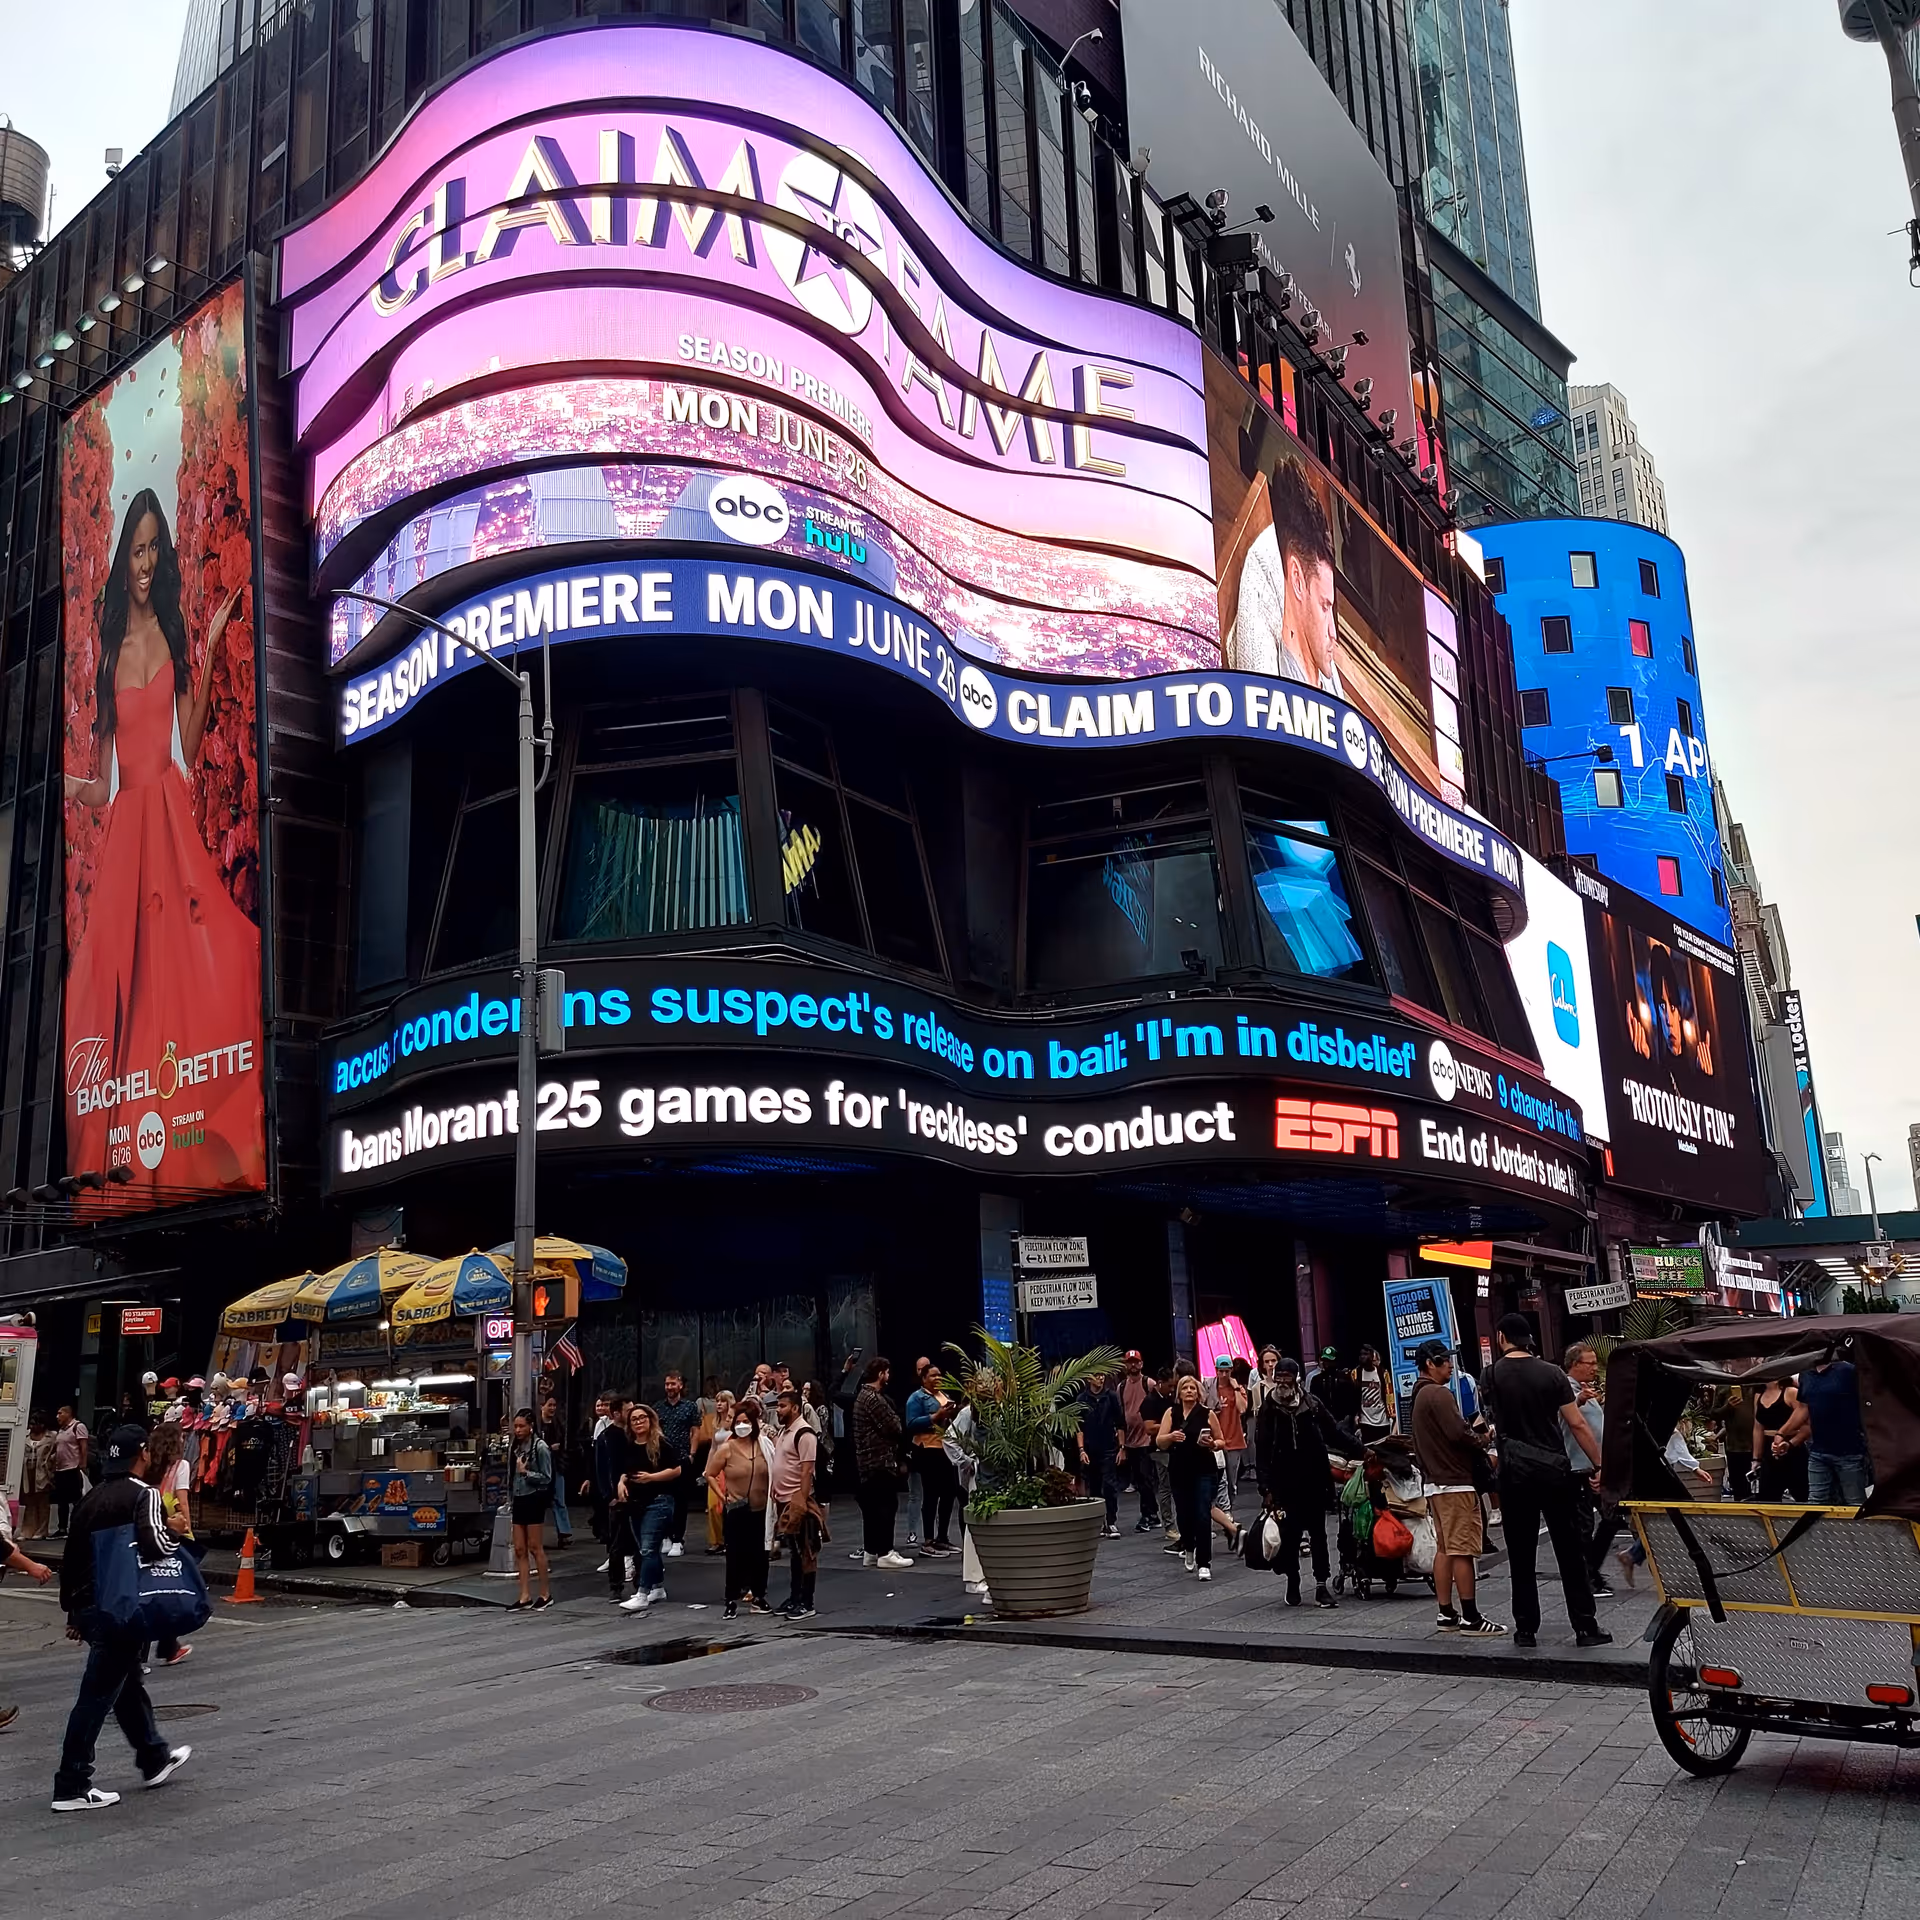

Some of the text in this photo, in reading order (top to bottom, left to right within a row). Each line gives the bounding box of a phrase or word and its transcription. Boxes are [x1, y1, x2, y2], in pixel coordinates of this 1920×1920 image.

[1198, 46, 1320, 232] RICHARD MILLE
[370, 124, 758, 318] CLAIM
[1298, 288, 1333, 343] FERARI
[882, 240, 1136, 479] FAME
[677, 334, 874, 446] SEASON PREMIERE
[662, 387, 870, 492] MON JUNE 26
[715, 495, 784, 524] abc
[806, 505, 867, 541] STREAM ON
[805, 518, 868, 564] hulu
[342, 629, 440, 738] SEASON
[443, 570, 674, 667] PREMIERE
[706, 572, 836, 641] MON
[848, 599, 932, 680] JUNE
[936, 644, 958, 704] 26
[961, 681, 994, 711] abc
[1006, 689, 1156, 739] CLAIM
[1165, 680, 1235, 729] TO
[1245, 684, 1339, 751] FAME
[1344, 728, 1367, 753] abc
[1410, 787, 1488, 868] PREMIERE
[1490, 837, 1522, 890] MON
[1619, 722, 1645, 768] 1
[1573, 865, 1610, 909] WEDNESDAY
[1551, 971, 1578, 1019] Calm
[66, 1033, 109, 1096] The
[336, 1028, 399, 1093] accusr
[401, 987, 632, 1057] condens
[650, 986, 895, 1040] suspect's
[903, 1010, 975, 1074] release
[983, 1046, 1036, 1080] on
[1047, 1030, 1129, 1080] bail:
[1135, 1015, 1225, 1062] 'I'm
[1237, 1014, 1278, 1058] in
[1286, 1022, 1417, 1079] disbelief'
[1432, 1057, 1455, 1081] abc
[1453, 1059, 1493, 1100] NEWS
[1496, 1073, 1508, 1110] 9
[1509, 1080, 1556, 1132] charged
[1554, 1101, 1567, 1136] in
[171, 1109, 205, 1128] STREAM ON
[109, 1125, 131, 1147] MON
[138, 1128, 166, 1151] abc
[172, 1125, 206, 1151] hulu
[340, 1127, 402, 1173] bans
[403, 1088, 520, 1156] Morant
[536, 1078, 602, 1131] 25
[618, 1084, 813, 1138] games
[824, 1079, 890, 1130] for
[898, 1087, 1028, 1157] 'reckless'
[1043, 1101, 1237, 1158] conduct
[1275, 1098, 1400, 1159] ESPN
[1419, 1118, 1468, 1171] End
[1472, 1130, 1489, 1169] of
[1490, 1134, 1547, 1187] Jordan's
[112, 1146, 132, 1167] 6/26
[1024, 1241, 1085, 1252] PEDESTRIAN FLOW ZONE
[1048, 1253, 1086, 1264] KEEP MOVING
[1654, 1255, 1701, 1268] BUCKS
[1029, 1280, 1093, 1295] PEDESTRIAN FLOW ZONE
[1391, 1288, 1431, 1306] EXPLORE
[1476, 1286, 1489, 1298] OPEN
[1568, 1288, 1606, 1301] PEDESTRIAN
[395, 1301, 451, 1322] SABRETT
[1030, 1295, 1066, 1307] KEEP MOVING
[1393, 1302, 1419, 1317] MORE
[1601, 1297, 1614, 1306] KEEP
[227, 1307, 289, 1325] SABRETT
[1395, 1310, 1435, 1328] IN TIMES
[487, 1320, 514, 1339] OP
[1397, 1321, 1435, 1338] SQUARE
[149, 1566, 180, 1578] store
